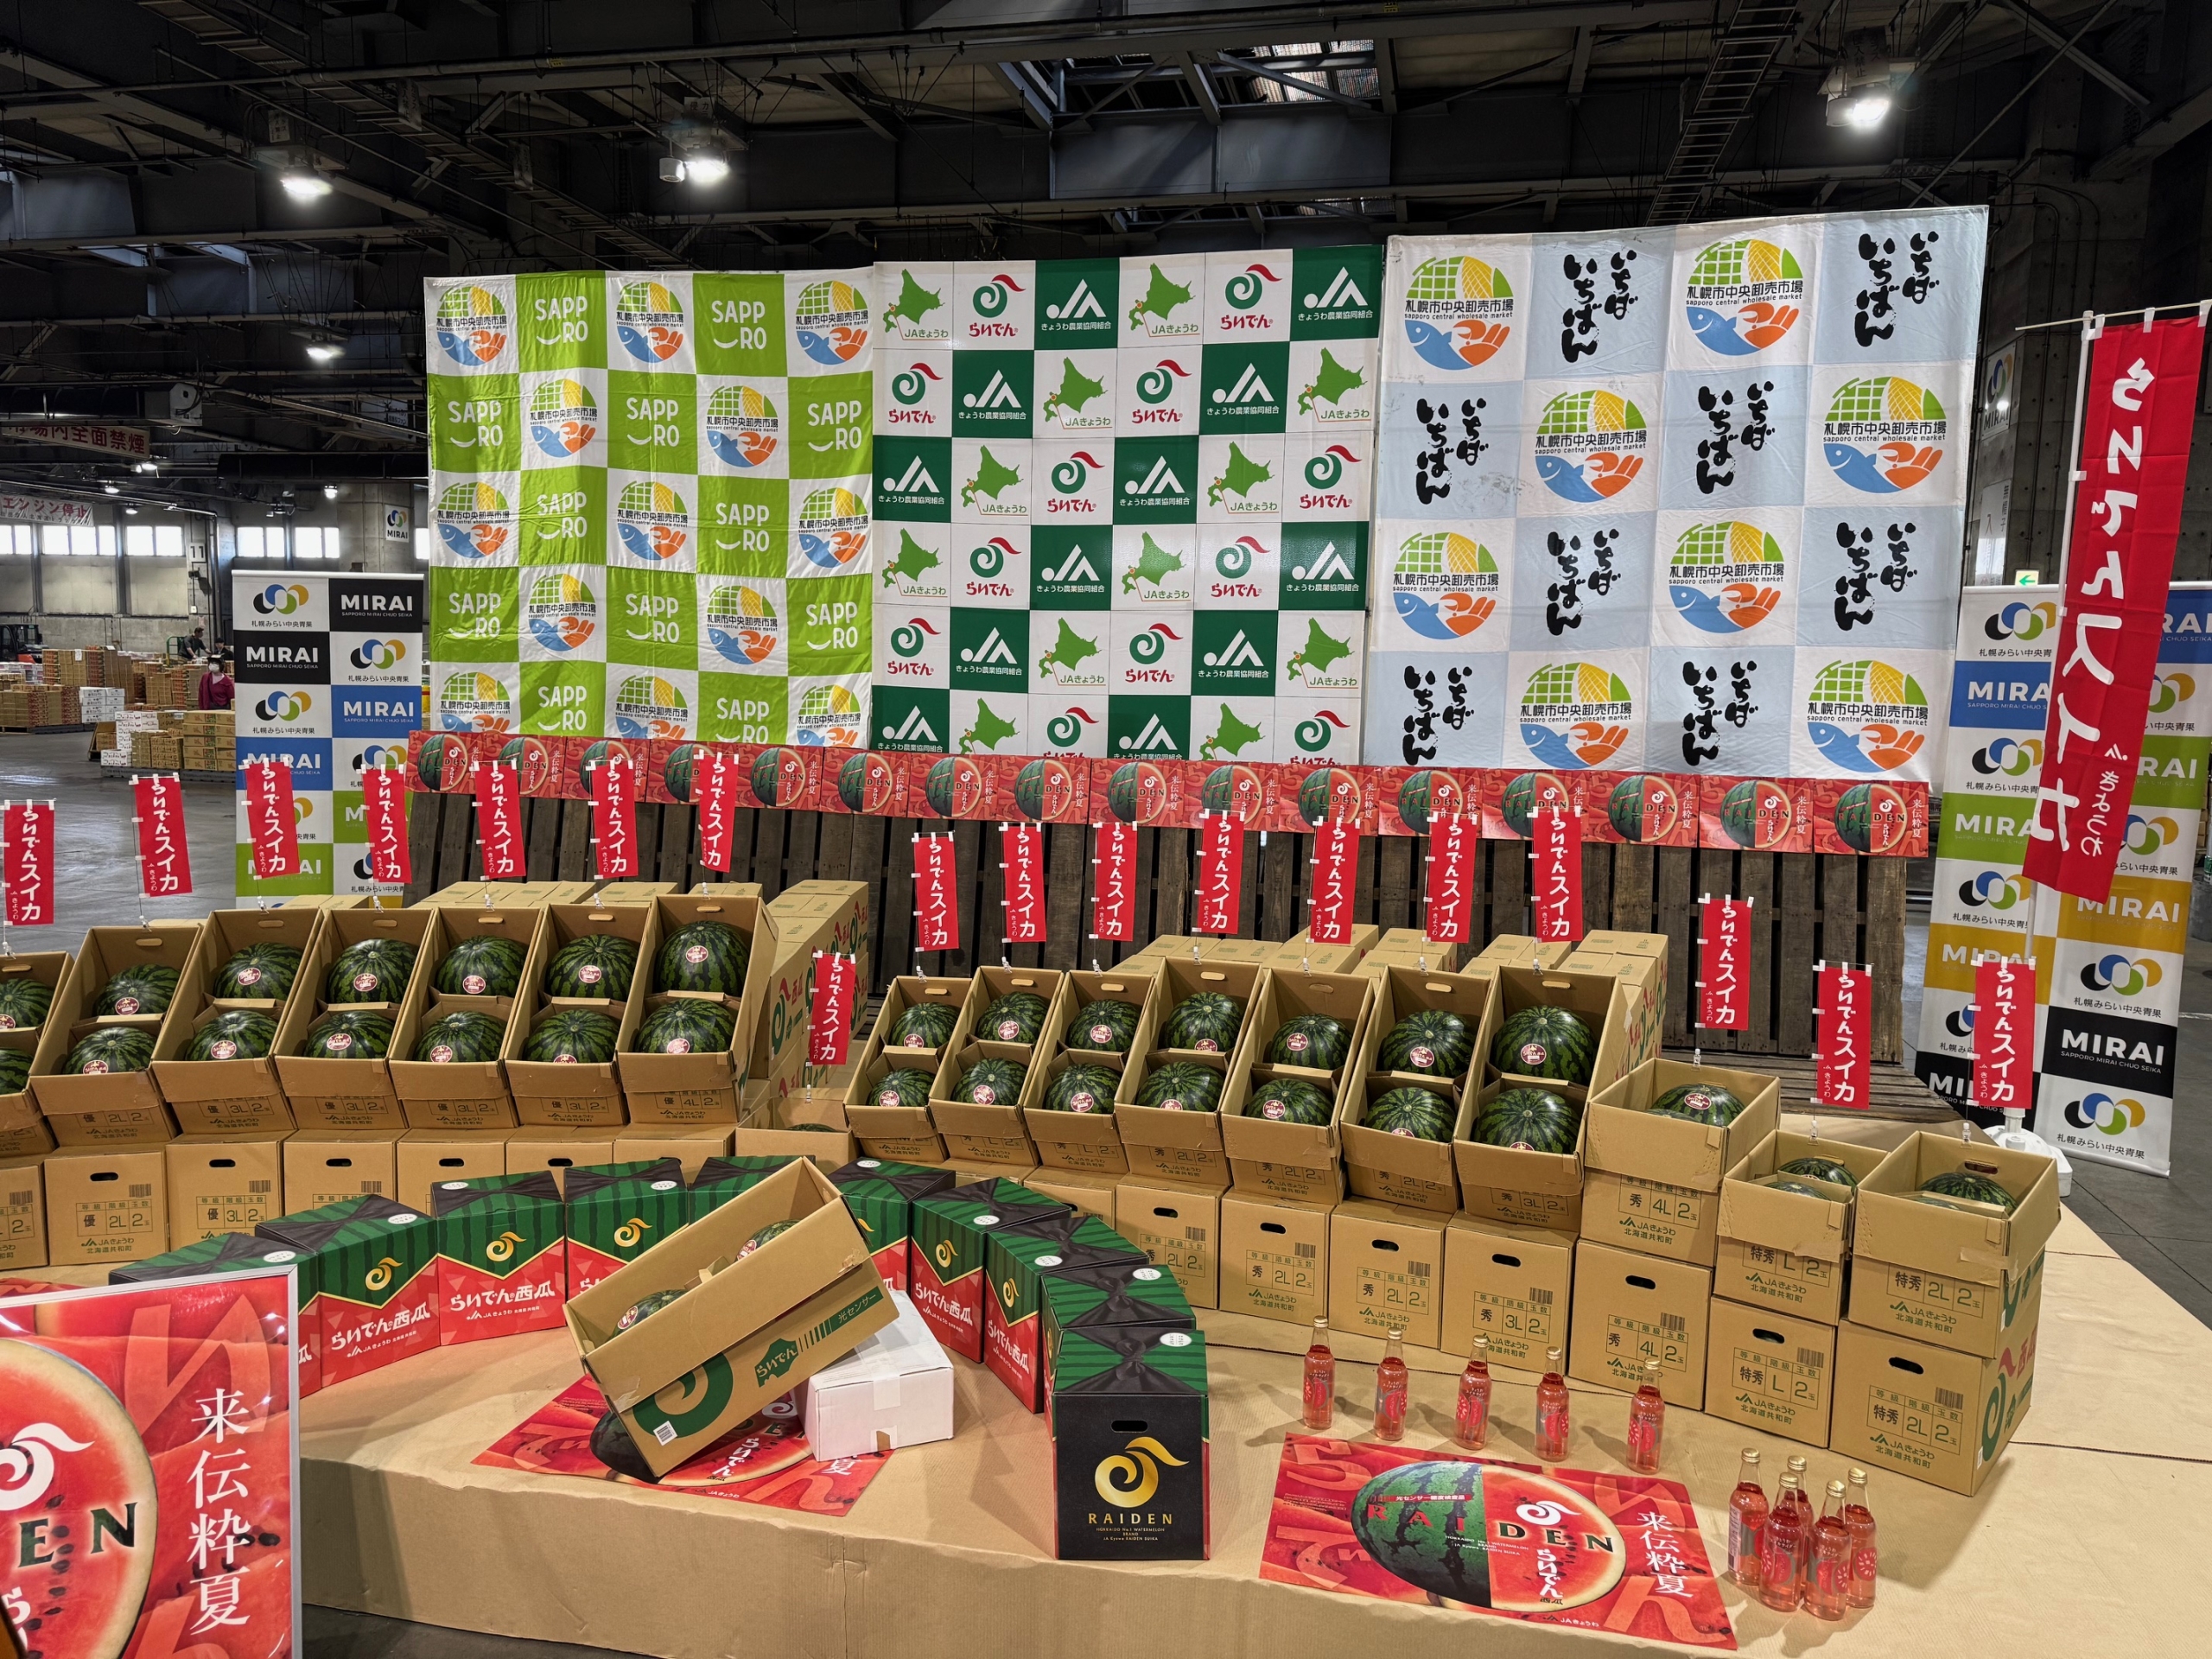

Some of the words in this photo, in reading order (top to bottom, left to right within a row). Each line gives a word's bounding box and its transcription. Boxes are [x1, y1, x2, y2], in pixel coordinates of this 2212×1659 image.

[1903, 232, 1940, 304] いちば
[1605, 250, 1637, 319] いちば
[1688, 280, 1803, 299] 札幌市中央卸売市場
[1854, 233, 1899, 346] いちばん
[535, 296, 588, 321] SAPP
[711, 301, 766, 323] SAPP
[1298, 309, 1373, 321] きょうわ農業協同組合
[1405, 298, 1514, 312] 札幌市中央卸売市場
[1560, 254, 1601, 362] いちばん
[561, 321, 588, 343] RO
[905, 327, 949, 339] JAきょうわ
[1041, 321, 1111, 331] きょうわ農業協同組合
[741, 327, 766, 349] RO
[807, 401, 861, 426] SAPP
[958, 411, 1027, 420] きょうわ農業協同組合
[1065, 416, 1111, 427] JAきょうわ
[1321, 409, 1370, 419] JAきょうわ
[1983, 408, 2009, 430] MIRAI
[836, 426, 861, 450] RO
[1535, 430, 1647, 448] 札幌市中央卸売市場
[1824, 420, 1947, 437] 札幌市中央卸売市場
[1120, 497, 1190, 506] きょうわ農業協同組合
[715, 504, 770, 526] SAPP
[387, 529, 409, 539] MIRAI
[743, 530, 770, 551] RO
[190, 545, 205, 559] 11
[1588, 529, 1620, 595] いちば
[1670, 563, 1784, 579] 札幌市中央卸売市場
[1547, 532, 1583, 635] いちばん
[341, 595, 412, 611] MIRAI
[247, 647, 318, 662] MIRAI
[1979, 649, 2052, 658] 札幌みらい中央青
[956, 665, 1022, 676] きょうわ農業協同組合
[1060, 674, 1104, 684] JAきょうわ
[538, 686, 587, 707] SAPP
[1443, 666, 1474, 730] いちば
[1968, 682, 2050, 702] MIRA
[344, 702, 413, 716] MIRAI
[1403, 666, 1438, 766] いちばん
[1808, 702, 1929, 721] 札幌市中央卸売市場
[563, 710, 587, 731] RO
[262, 767, 286, 873] らいでんスイカ
[490, 769, 514, 874] らいでんスイカ
[706, 760, 725, 866] らいでんスイカ
[1796, 796, 1808, 835] 来伝粋夏
[1912, 799, 1923, 838] 来伝粋夏
[151, 782, 179, 892] らいでんスイカ
[378, 774, 401, 879] らいでんスイカ
[19, 808, 41, 921] らいでんスイカ
[1211, 817, 1230, 930] らいでんスイカ
[1551, 817, 1570, 938] らいでんスイカ
[930, 838, 947, 946] らいでんスイカ
[820, 963, 843, 1060] らいでんスイカ
[2074, 997, 2162, 1018] 札幌みらい中央青果
[1991, 968, 2017, 1102] らいでんスイカ
[2062, 1030, 2164, 1065] MIRAI
[2061, 1051, 2094, 1062] SAPPORO
[2096, 1057, 2117, 1066] MIRAI
[2120, 1061, 2139, 1070] CHUO
[2141, 1065, 2162, 1074] SEIKA
[2056, 1134, 2145, 1160] 札幌みらい中央青果
[1630, 1193, 1642, 1207] 秀
[1653, 1198, 1671, 1216] 4L
[83, 1215, 95, 1227] 優
[109, 1216, 126, 1228] 2L
[1637, 1223, 1675, 1236] JAきょうわ
[1624, 1228, 1672, 1244] 北海道共和町
[1252, 1265, 1262, 1278] 秀
[1274, 1270, 1291, 1285] 2L
[1895, 1272, 1922, 1291] 特秀
[1928, 1281, 1949, 1300] 2L
[838, 1294, 876, 1324] 光センサー
[1253, 1299, 1294, 1312] 北海道共和町
[1264, 1293, 1297, 1304] JAきょうわ
[1896, 1313, 1953, 1334] 北海道共和町
[1911, 1307, 1957, 1325] JAきょうわ
[1740, 1366, 1764, 1385] 特秀
[1773, 1375, 1784, 1393] L
[1740, 1404, 1792, 1424] 北海道共和町
[1754, 1399, 1796, 1415] JAきょうわ
[1873, 1404, 1899, 1424] 特秀
[1906, 1416, 1928, 1436] 2L
[1875, 1445, 1930, 1469] 北海道共和町
[1891, 1441, 1935, 1459] JAきょうわ
[186, 1388, 251, 1636] 来伝粋夏
[1089, 1513, 1172, 1524] RAIDEN
[1637, 1511, 1694, 1598] 来伝粋夏
